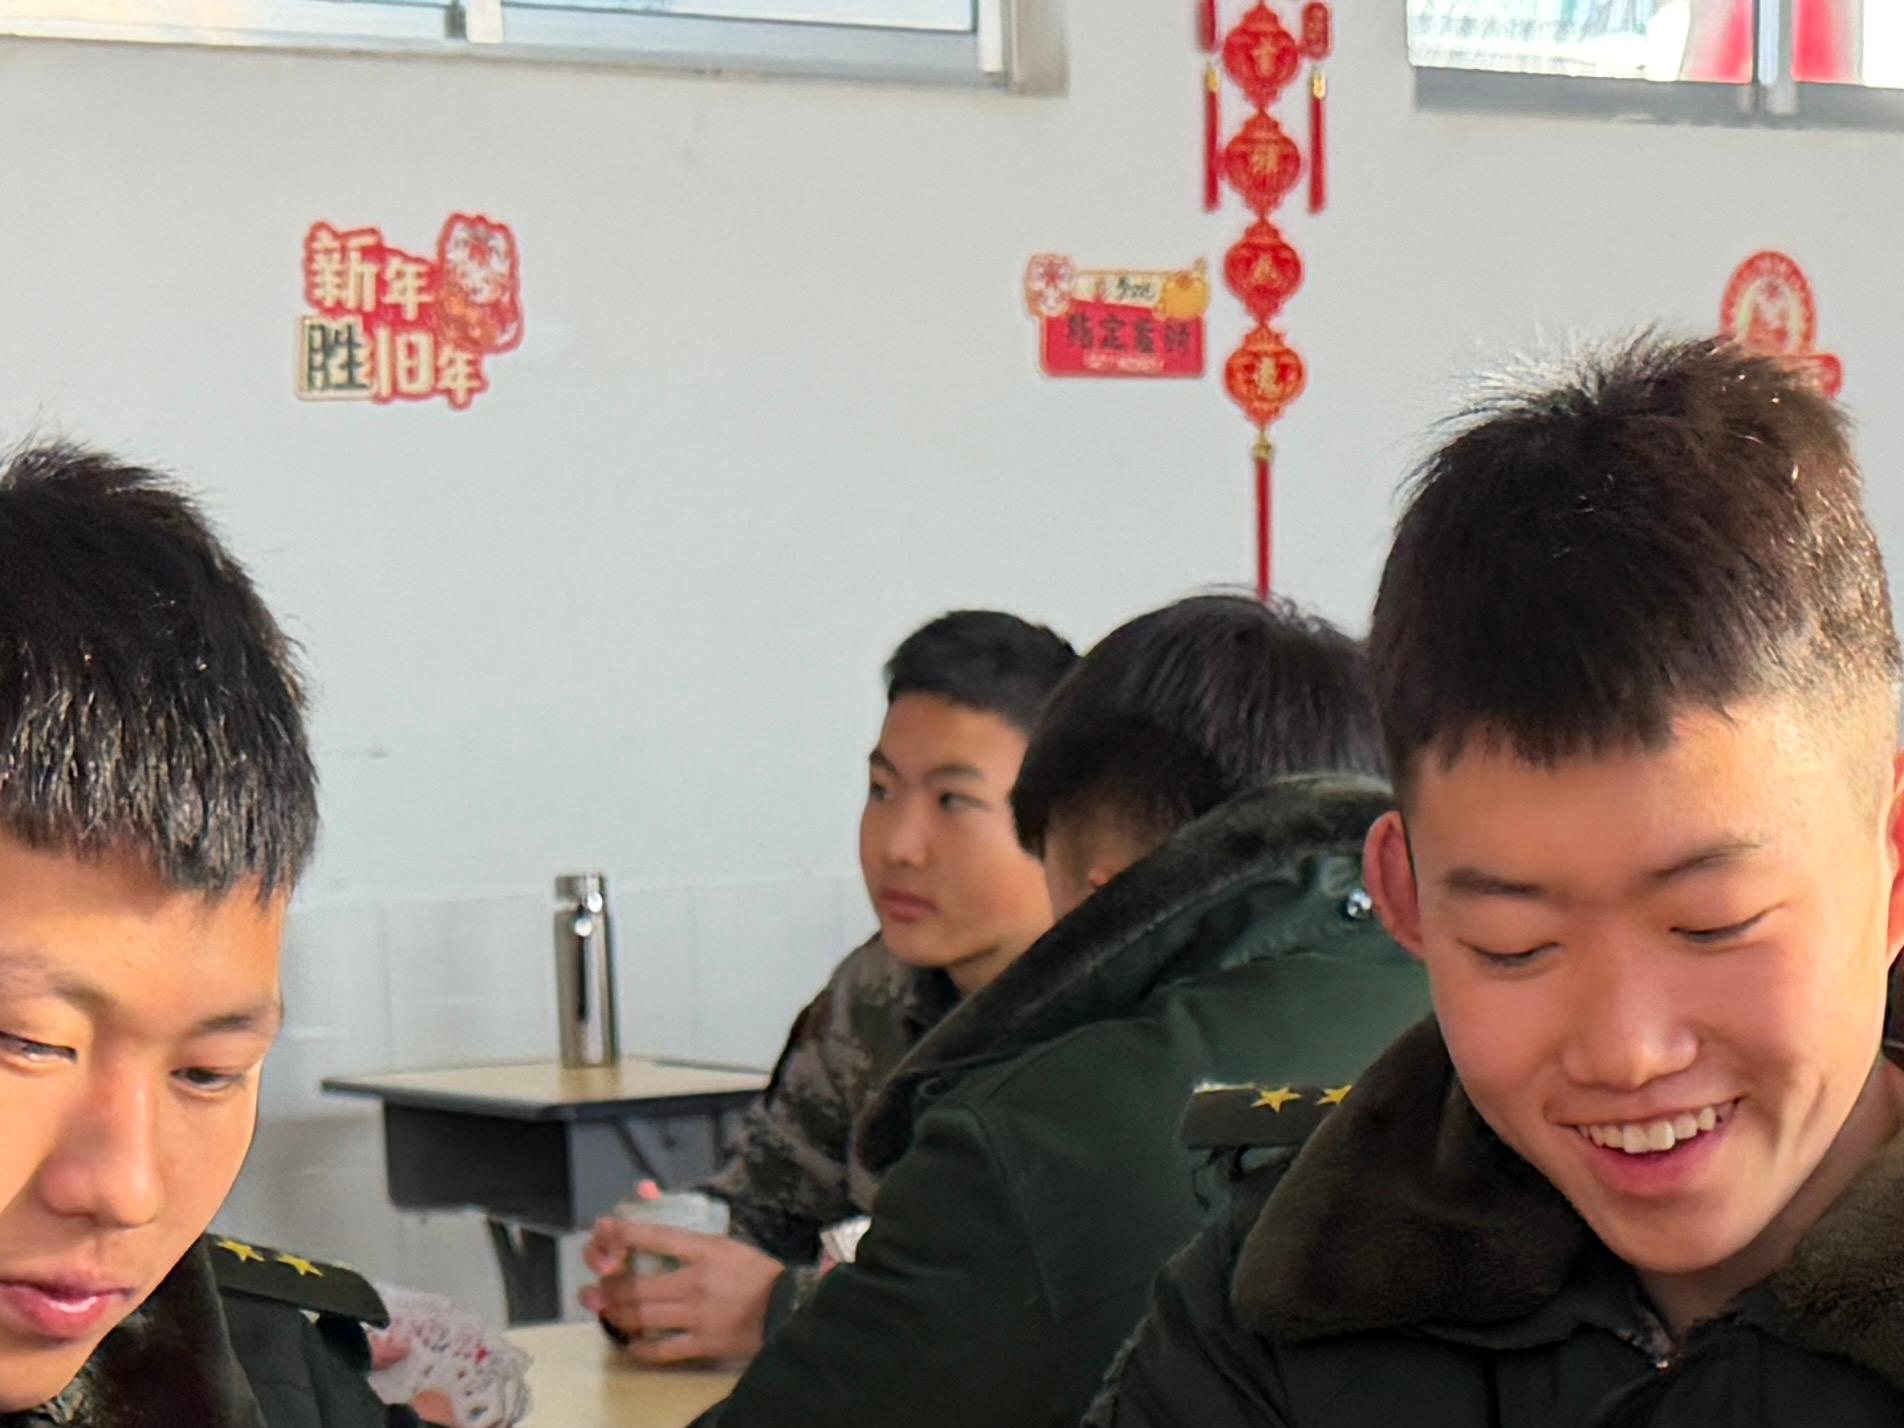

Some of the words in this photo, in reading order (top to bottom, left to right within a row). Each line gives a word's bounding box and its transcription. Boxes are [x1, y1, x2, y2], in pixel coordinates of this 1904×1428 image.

[309, 227, 435, 322] 新年
[308, 324, 482, 405] 胜旧年
